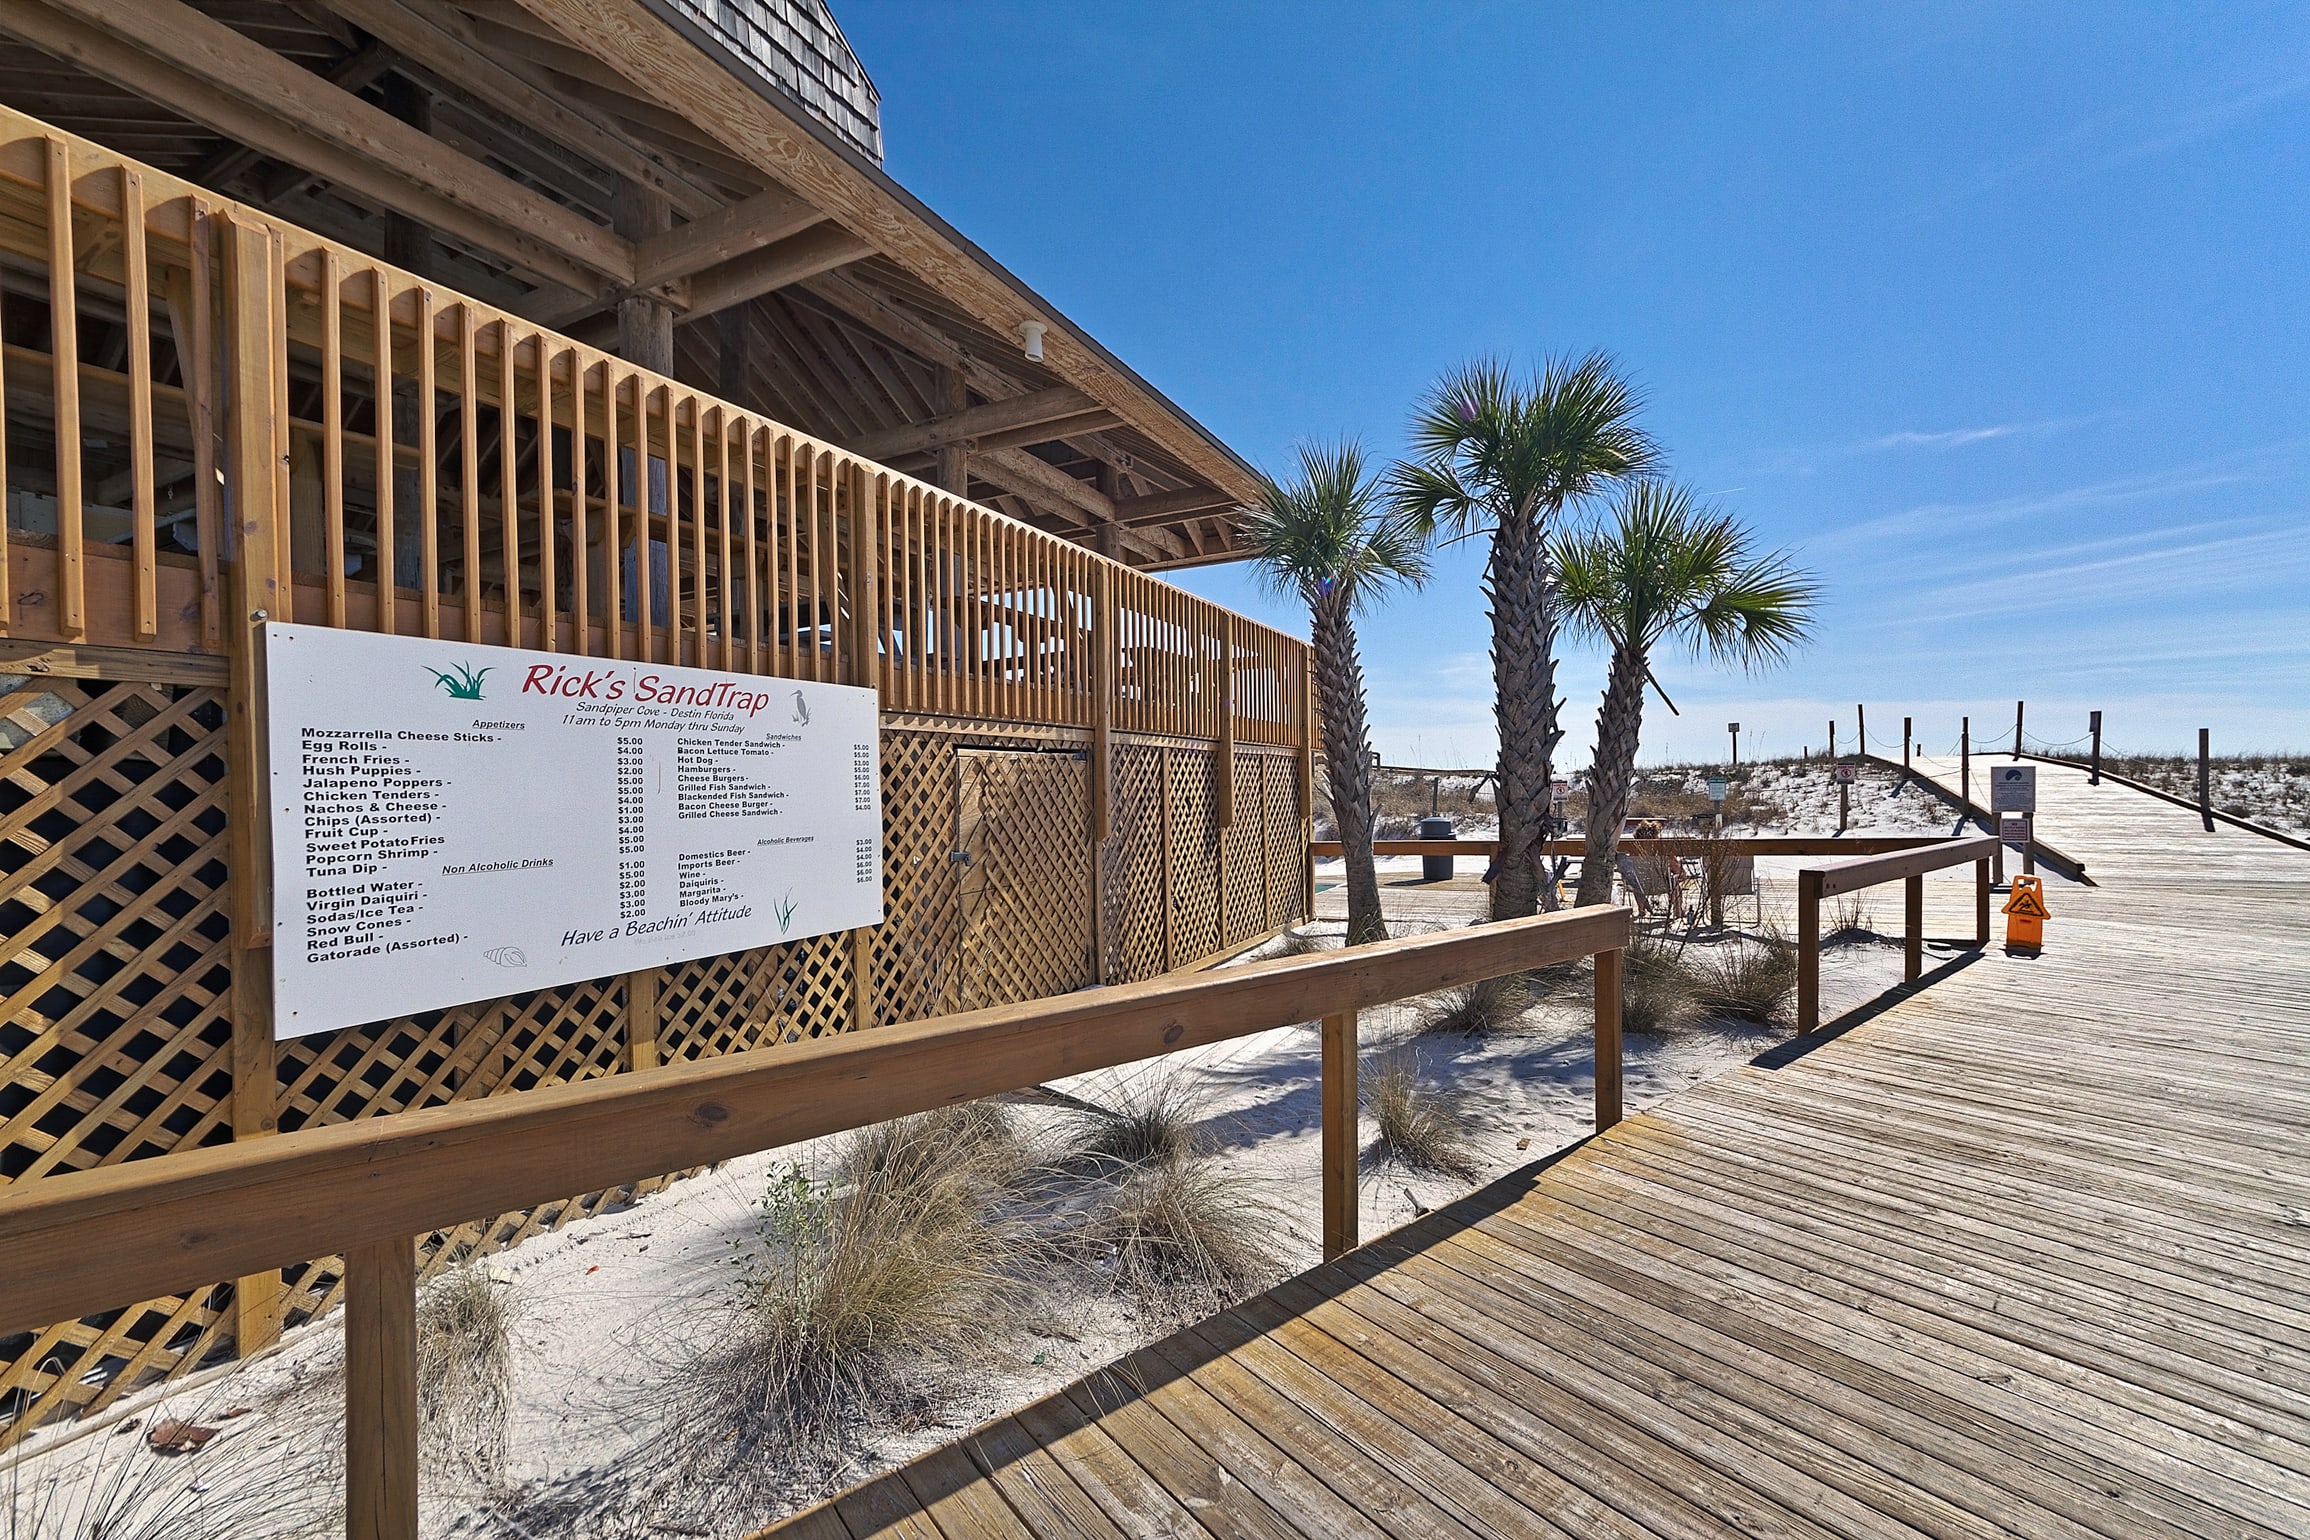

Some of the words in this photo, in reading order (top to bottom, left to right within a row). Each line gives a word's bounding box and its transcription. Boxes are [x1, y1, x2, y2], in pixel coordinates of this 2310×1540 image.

[522, 665, 626, 700] Rick's
[635, 675, 769, 717] SandTrap
[576, 702, 634, 716] Sandpiper
[637, 706, 660, 716] Cove
[671, 708, 702, 719] Destin
[705, 711, 734, 720] Florida
[472, 720, 525, 730] Appetizers
[562, 714, 596, 726] 11am
[600, 717, 611, 726] to
[615, 717, 641, 729] 5pm
[644, 720, 685, 733] Monday
[688, 722, 708, 731] thru
[711, 724, 745, 734] Sunday
[302, 728, 392, 739] Mozzarrella
[398, 731, 449, 741] Cheese
[454, 733, 494, 742] Sticks
[302, 741, 332, 752] Egg
[339, 741, 377, 751] Rolls
[617, 737, 642, 746] $5.00
[678, 738, 712, 746] Chicken
[744, 740, 780, 748] Sandwich
[618, 747, 642, 755] $4.00
[678, 747, 705, 755] Bacon
[302, 754, 358, 764] French
[364, 755, 400, 764] Fries
[618, 758, 643, 766] $3.00
[697, 757, 712, 765] Dog
[303, 766, 345, 775] Hush
[351, 766, 411, 777] Puppies
[618, 767, 643, 775] $2.00
[678, 766, 731, 774] Hamburgers
[303, 778, 377, 790] Jalapeno
[384, 778, 442, 789] Poppers
[618, 777, 643, 785] $5.00
[618, 786, 643, 795] $5.00
[678, 783, 707, 792] Grilled
[709, 783, 726, 791] Fish
[729, 783, 766, 791] Sandwich
[304, 790, 367, 801] Chicken
[372, 790, 430, 800] Tenders
[618, 796, 643, 804] $4.00
[679, 792, 728, 801] Blackended
[304, 803, 363, 814] Nachos
[370, 803, 380, 812] &
[386, 802, 437, 811] Cheese
[742, 800, 768, 809] Burger
[618, 806, 643, 814] $1.00
[679, 811, 707, 819] Grilled
[710, 810, 740, 818] Cheese
[305, 816, 349, 827] Chips
[355, 813, 432, 826] (Assorted)
[618, 816, 643, 824] $3.00
[305, 828, 343, 839] Fruit
[349, 827, 378, 838] Cup
[618, 826, 644, 834] $4.00
[619, 835, 644, 844] $5.00
[757, 838, 784, 846] Alcoholic
[786, 836, 814, 844] Beverages
[306, 841, 357, 852] Sweet
[619, 845, 644, 854] $5.00
[306, 853, 372, 865] Popcorn
[378, 848, 429, 860] Shrimp
[679, 851, 724, 861] Domestics
[727, 849, 746, 857] Beer
[442, 865, 465, 875] Non
[468, 860, 518, 873] Alcoholic
[521, 857, 553, 869] Drinks
[619, 860, 645, 869] $1.00
[678, 860, 713, 871] Imports
[306, 867, 347, 877] Tuna
[353, 864, 377, 875] Dip
[620, 870, 645, 879] $5.00
[679, 871, 701, 879] Wine
[620, 880, 645, 889] $2.00
[679, 877, 719, 889] Daiquiris
[307, 885, 365, 899] Bottled
[371, 880, 414, 892] Water
[620, 890, 645, 899] $3.00
[680, 886, 721, 899] Margarita
[307, 898, 355, 912] Virgin
[361, 891, 418, 906] Daiquiri
[620, 899, 645, 909] $3.00
[680, 897, 710, 908] Bloody
[712, 893, 739, 904] Mary's
[307, 908, 383, 924] Sodas/Ice
[389, 904, 414, 915] Tea
[620, 909, 646, 919] $2.00
[307, 925, 351, 937] Snow
[357, 918, 402, 931] Cones
[561, 930, 603, 946] Have
[609, 928, 619, 939] a
[625, 912, 693, 936] Beachin'
[695, 905, 752, 926] Attitude
[308, 938, 338, 950] Red
[345, 933, 374, 945] Bull
[307, 945, 381, 963] Gatorade
[386, 933, 460, 954] (Assorted)
